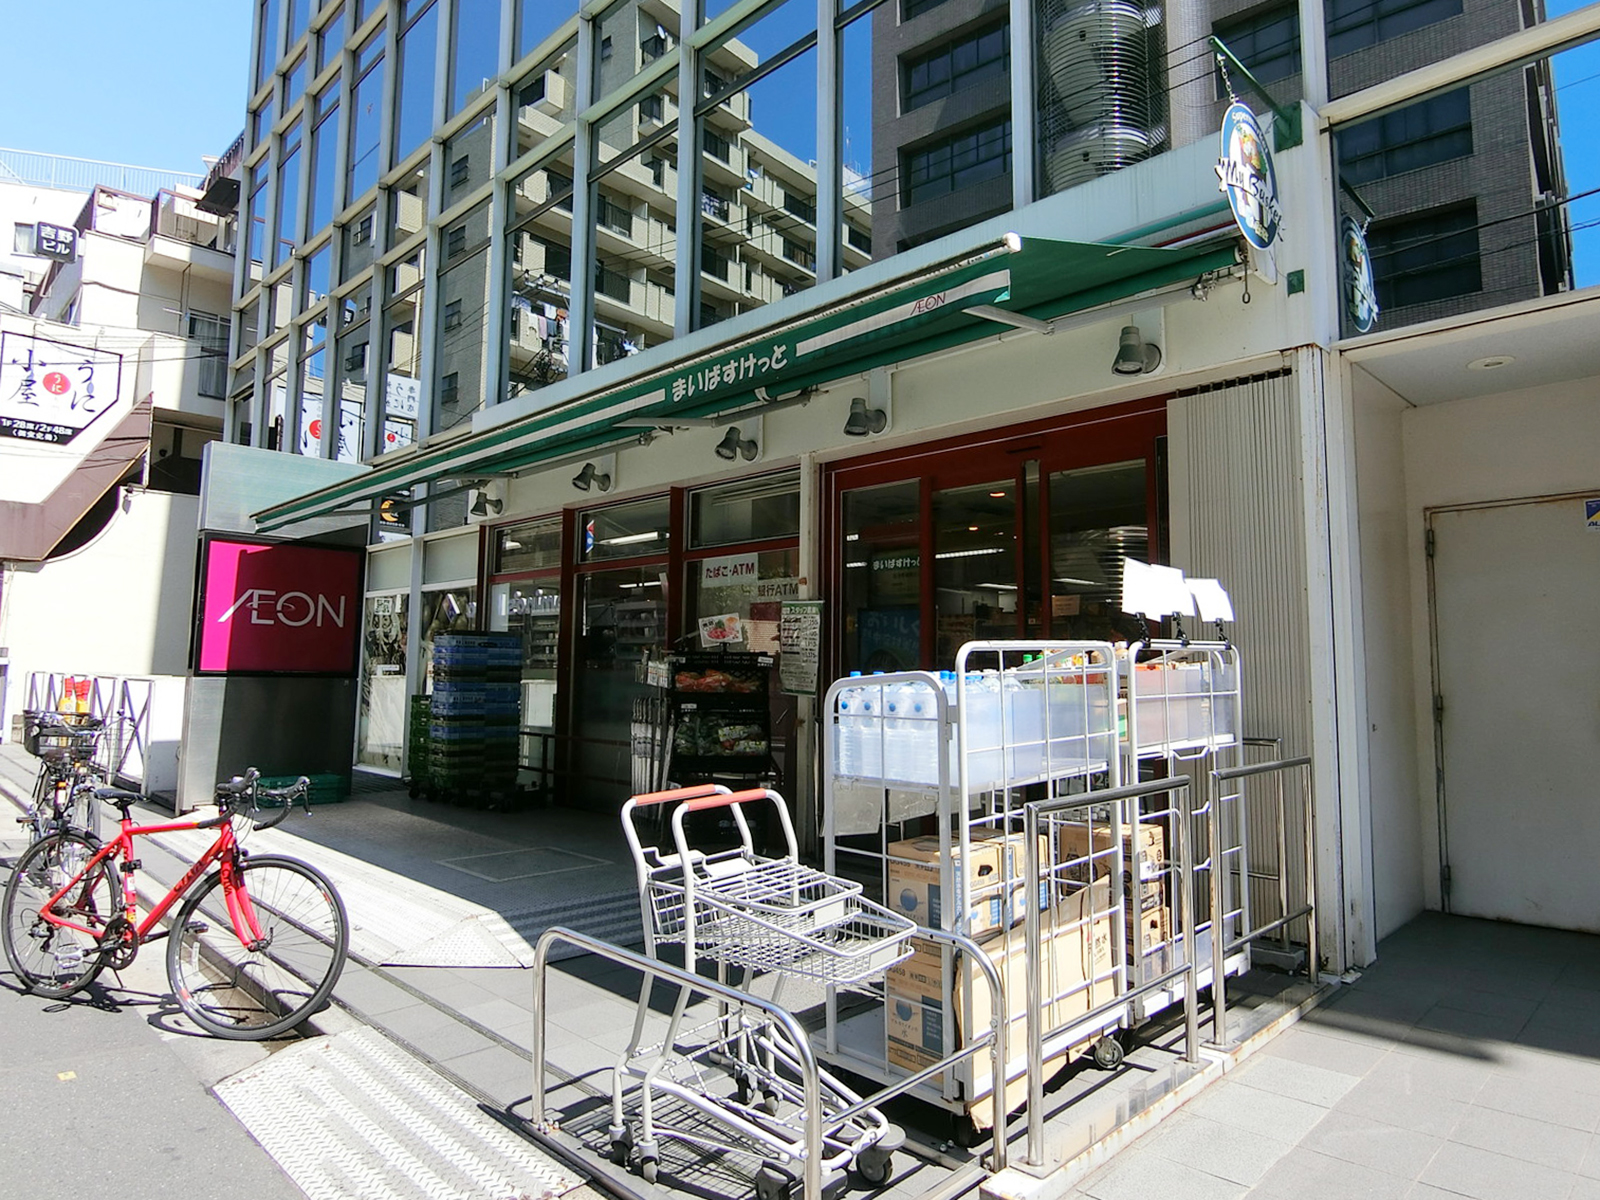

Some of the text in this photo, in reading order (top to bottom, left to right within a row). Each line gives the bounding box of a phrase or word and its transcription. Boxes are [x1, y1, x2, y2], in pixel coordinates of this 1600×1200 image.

[43, 239, 70, 254] ビル
[71, 359, 96, 412] うに
[671, 344, 788, 402] まいばすけっと
